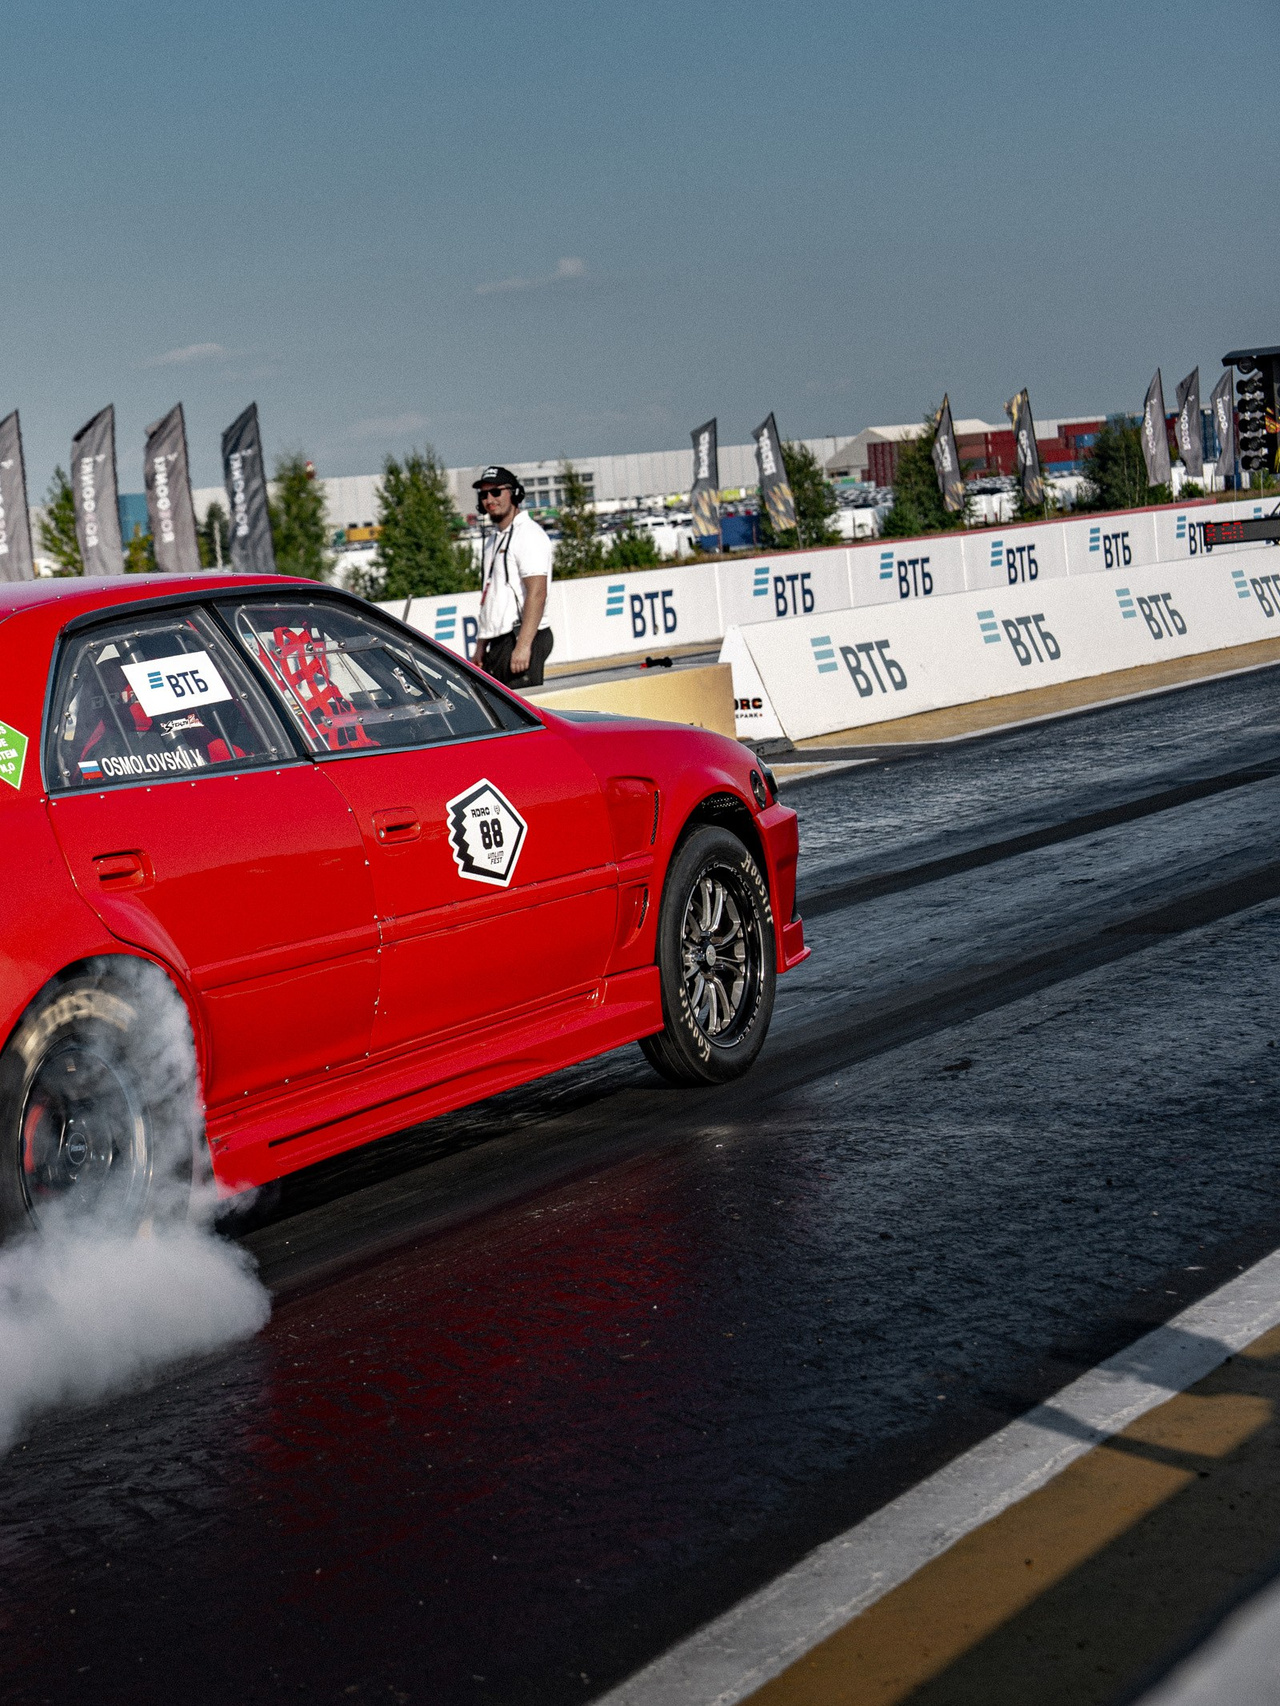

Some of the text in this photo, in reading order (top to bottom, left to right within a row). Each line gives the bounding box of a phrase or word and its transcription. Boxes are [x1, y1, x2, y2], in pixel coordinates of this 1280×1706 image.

[1006, 544, 1039, 584] ВТБ
[1104, 531, 1132, 568] ВТБ
[773, 572, 815, 617] ВТБ
[897, 557, 933, 599] ВТБ
[630, 589, 678, 638] ВТБ
[1136, 592, 1188, 640] ВТБ
[1001, 613, 1062, 667] ВТБ
[165, 669, 210, 698] ВТБ
[839, 639, 908, 698] ВТБ
[470, 806, 491, 818] RDRC
[479, 818, 504, 850] 88
